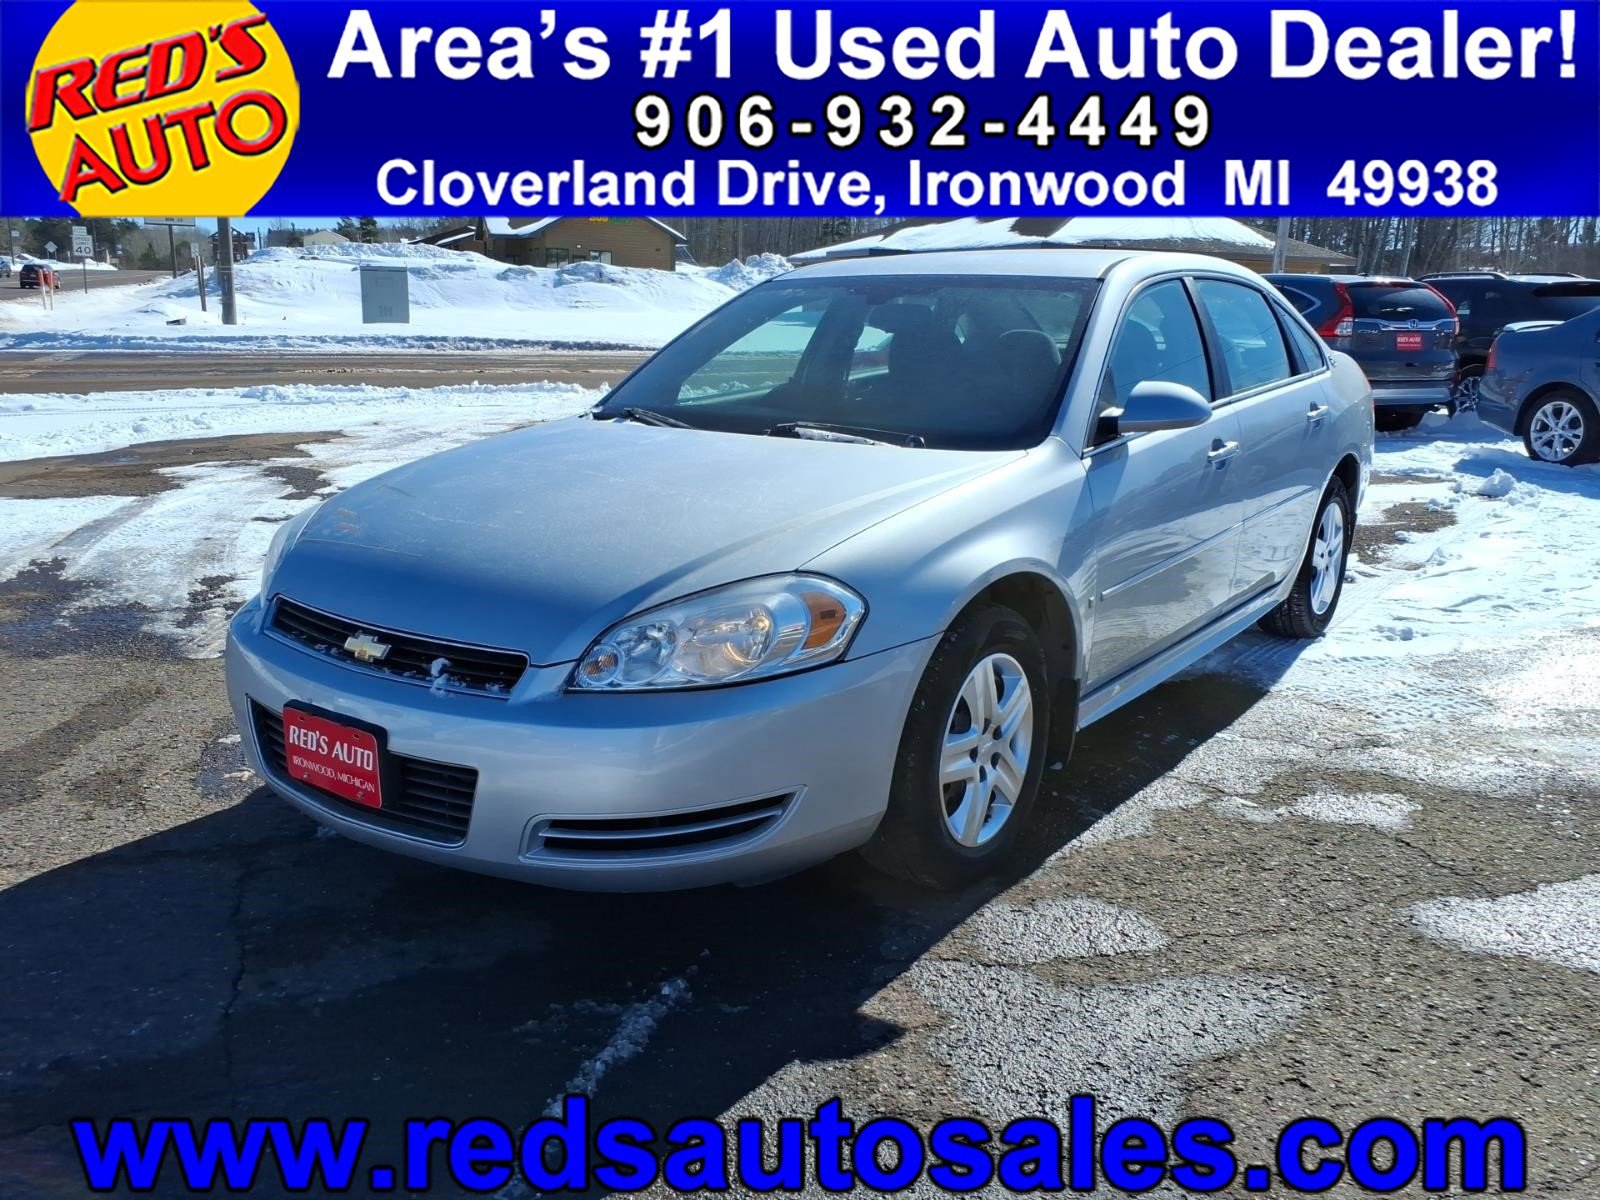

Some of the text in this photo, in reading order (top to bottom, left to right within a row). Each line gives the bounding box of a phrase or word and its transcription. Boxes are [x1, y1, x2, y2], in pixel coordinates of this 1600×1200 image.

[75, 246, 92, 254] 40
[289, 725, 373, 771] RED'S AUTO
[292, 755, 375, 793] IRONWOOD, MICHIGAN
